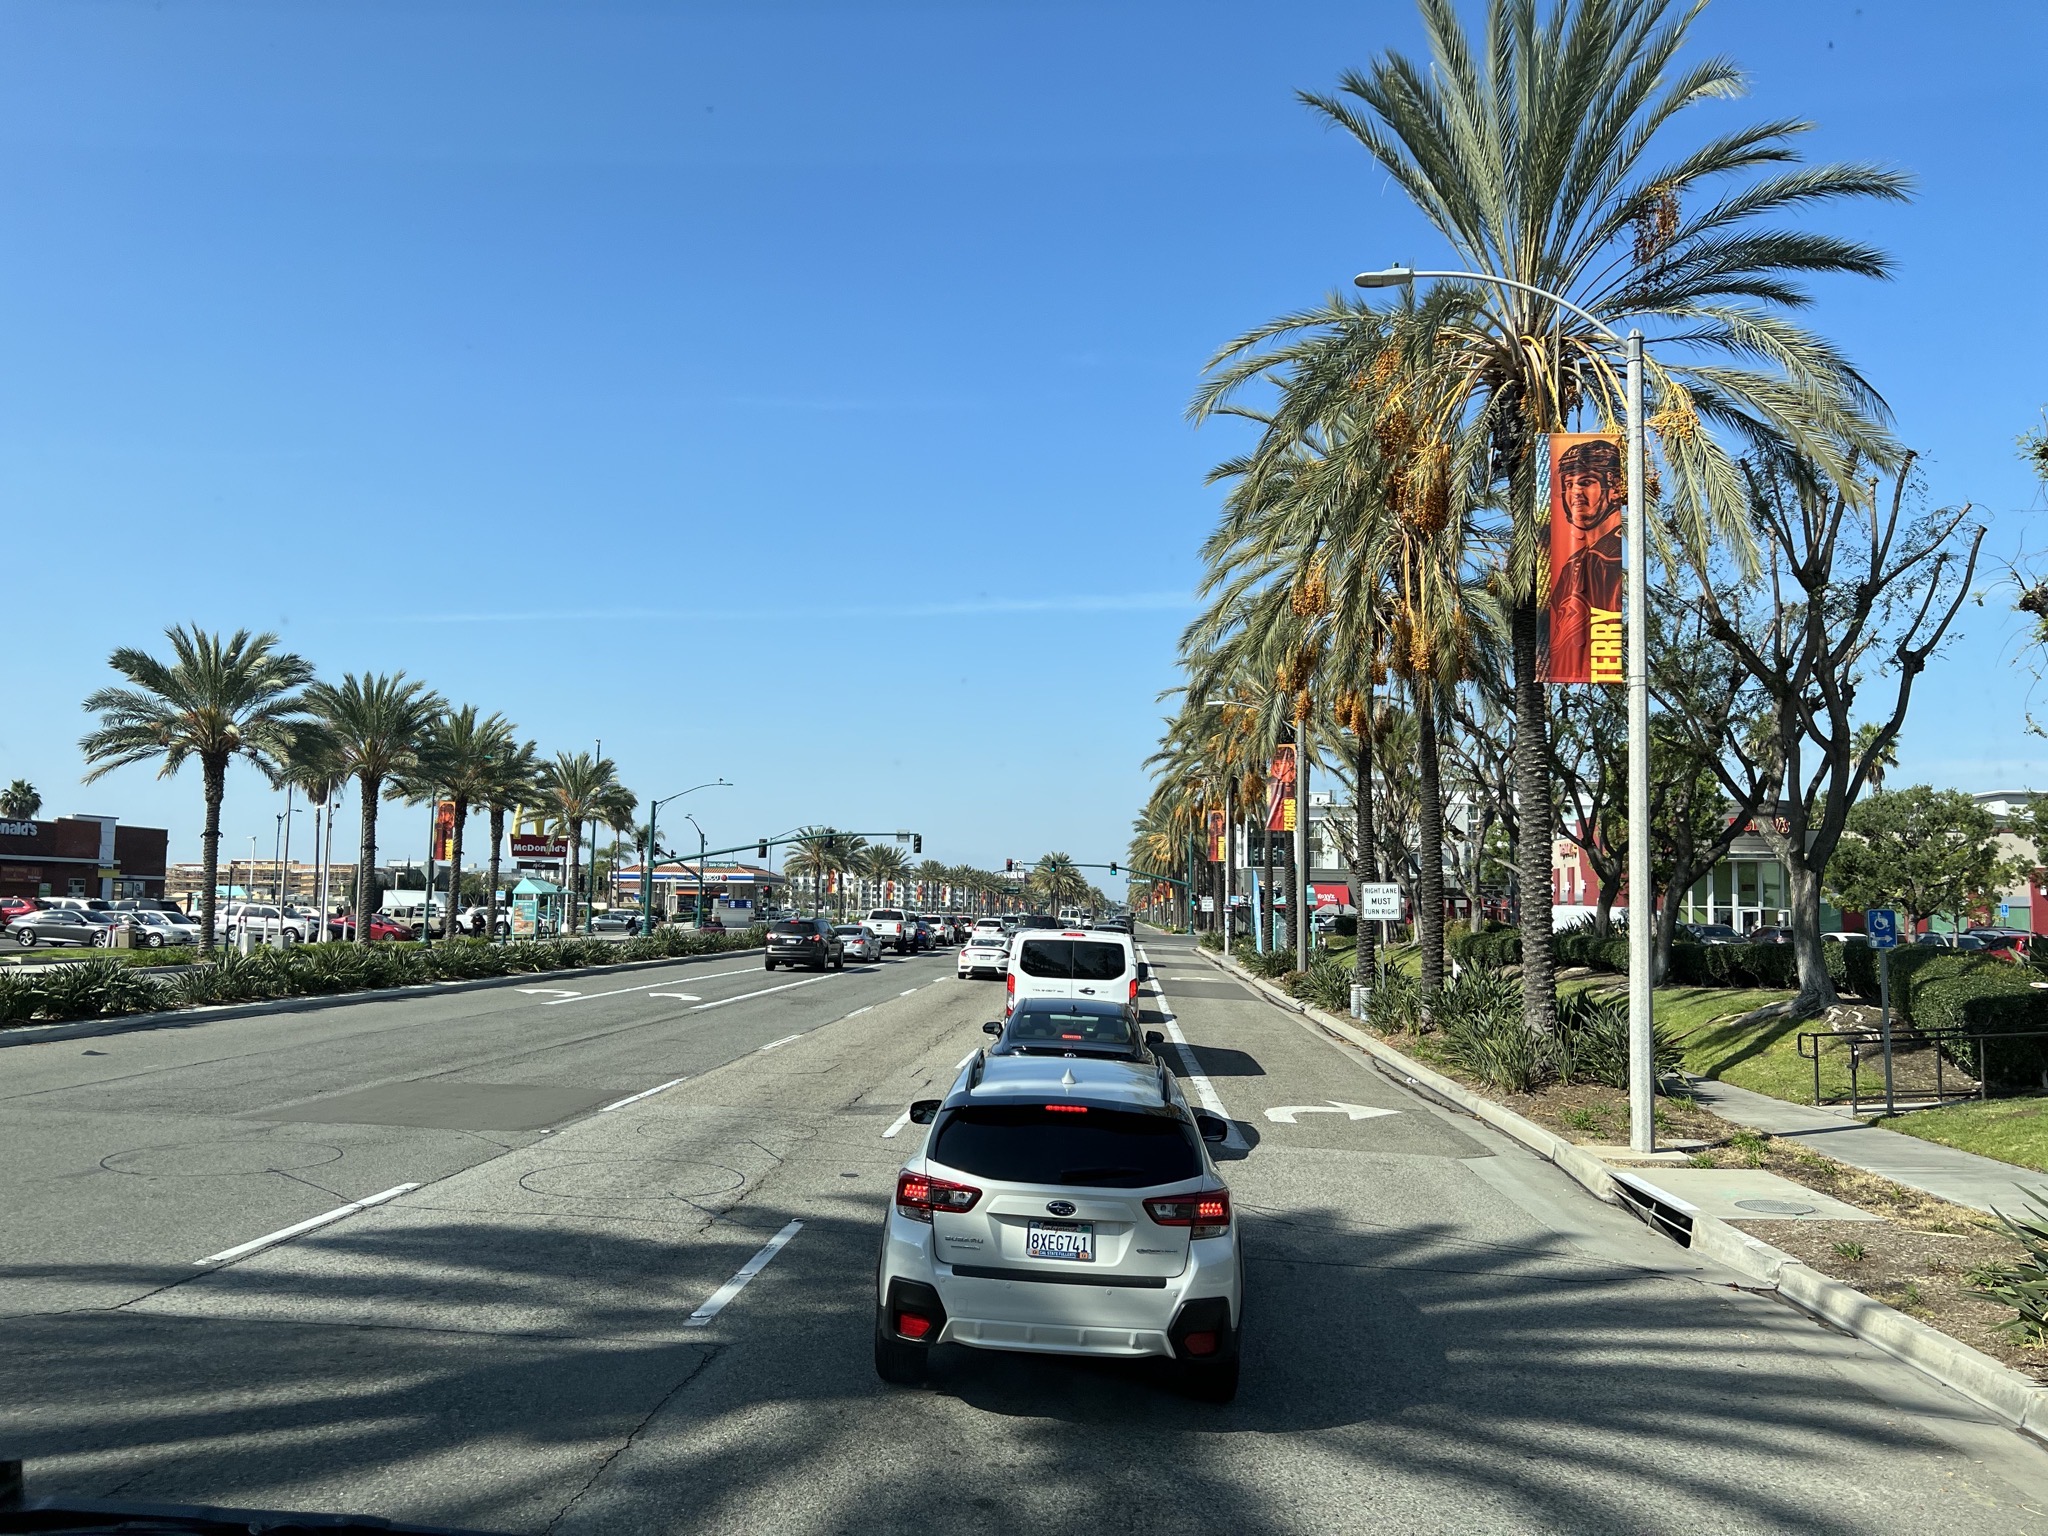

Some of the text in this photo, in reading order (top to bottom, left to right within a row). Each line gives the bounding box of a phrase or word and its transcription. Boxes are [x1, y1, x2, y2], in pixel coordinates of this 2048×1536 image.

[1590, 607, 1623, 683] TERRY
[1284, 799, 1296, 831] ZEGRAS
[513, 844, 567, 853] McDonld's
[1371, 897, 1391, 905] MUST
[945, 1235, 984, 1244] SUBARU
[1031, 1233, 1087, 1253] 8XEG741
